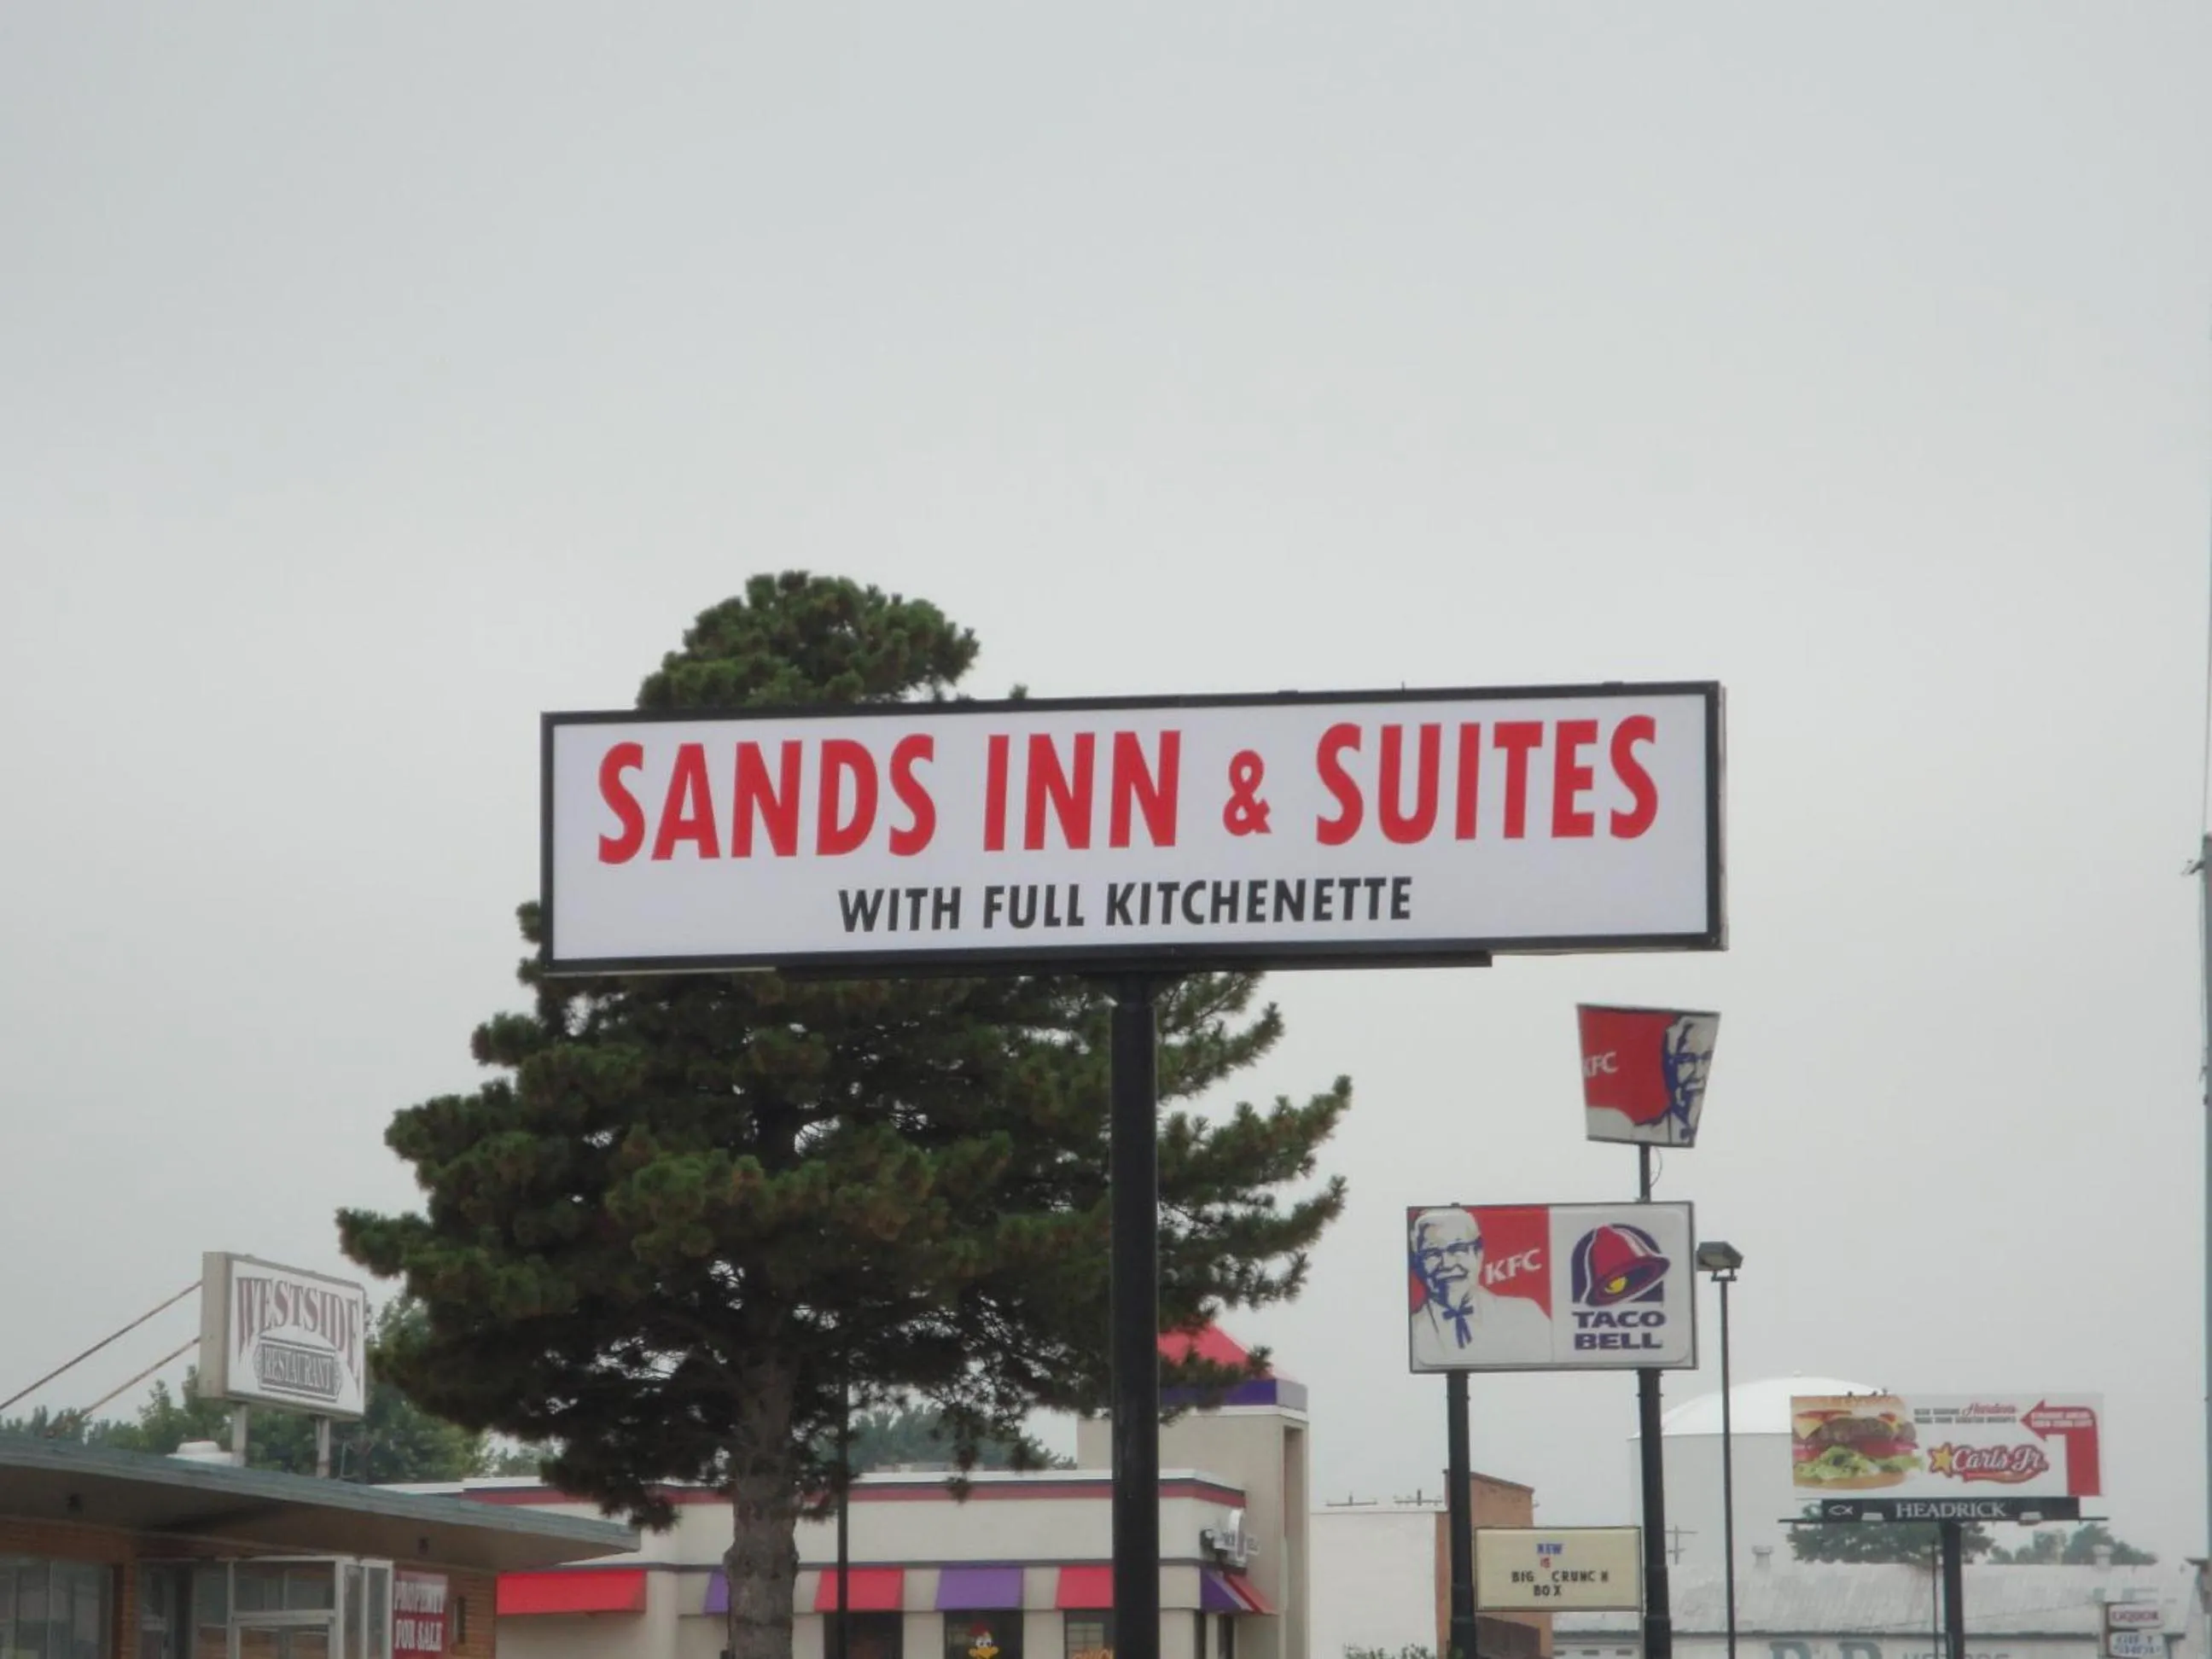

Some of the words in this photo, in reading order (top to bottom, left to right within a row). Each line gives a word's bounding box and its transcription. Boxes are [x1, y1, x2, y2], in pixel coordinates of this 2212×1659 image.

[599, 735, 935, 864] SANDS
[985, 731, 1180, 851] INN
[1223, 750, 1268, 835] &
[1316, 715, 1657, 845] SUITES
[839, 887, 961, 932] WITH
[983, 884, 1085, 928] FULL
[1106, 876, 1412, 926] KITCHENETTE
[1486, 1249, 1540, 1284] KFC
[236, 1277, 359, 1396] WESTSIDE
[1572, 1311, 1666, 1329] TACO
[1575, 1332, 1662, 1350] BELL
[264, 1346, 330, 1390] RESTAURANT
[1895, 1501, 2007, 1519] HEADRICK
[1511, 1570, 1534, 1583] BIG
[1534, 1584, 1563, 1597] BOX
[395, 1619, 416, 1650] FOR
[416, 1620, 443, 1652] SALE
